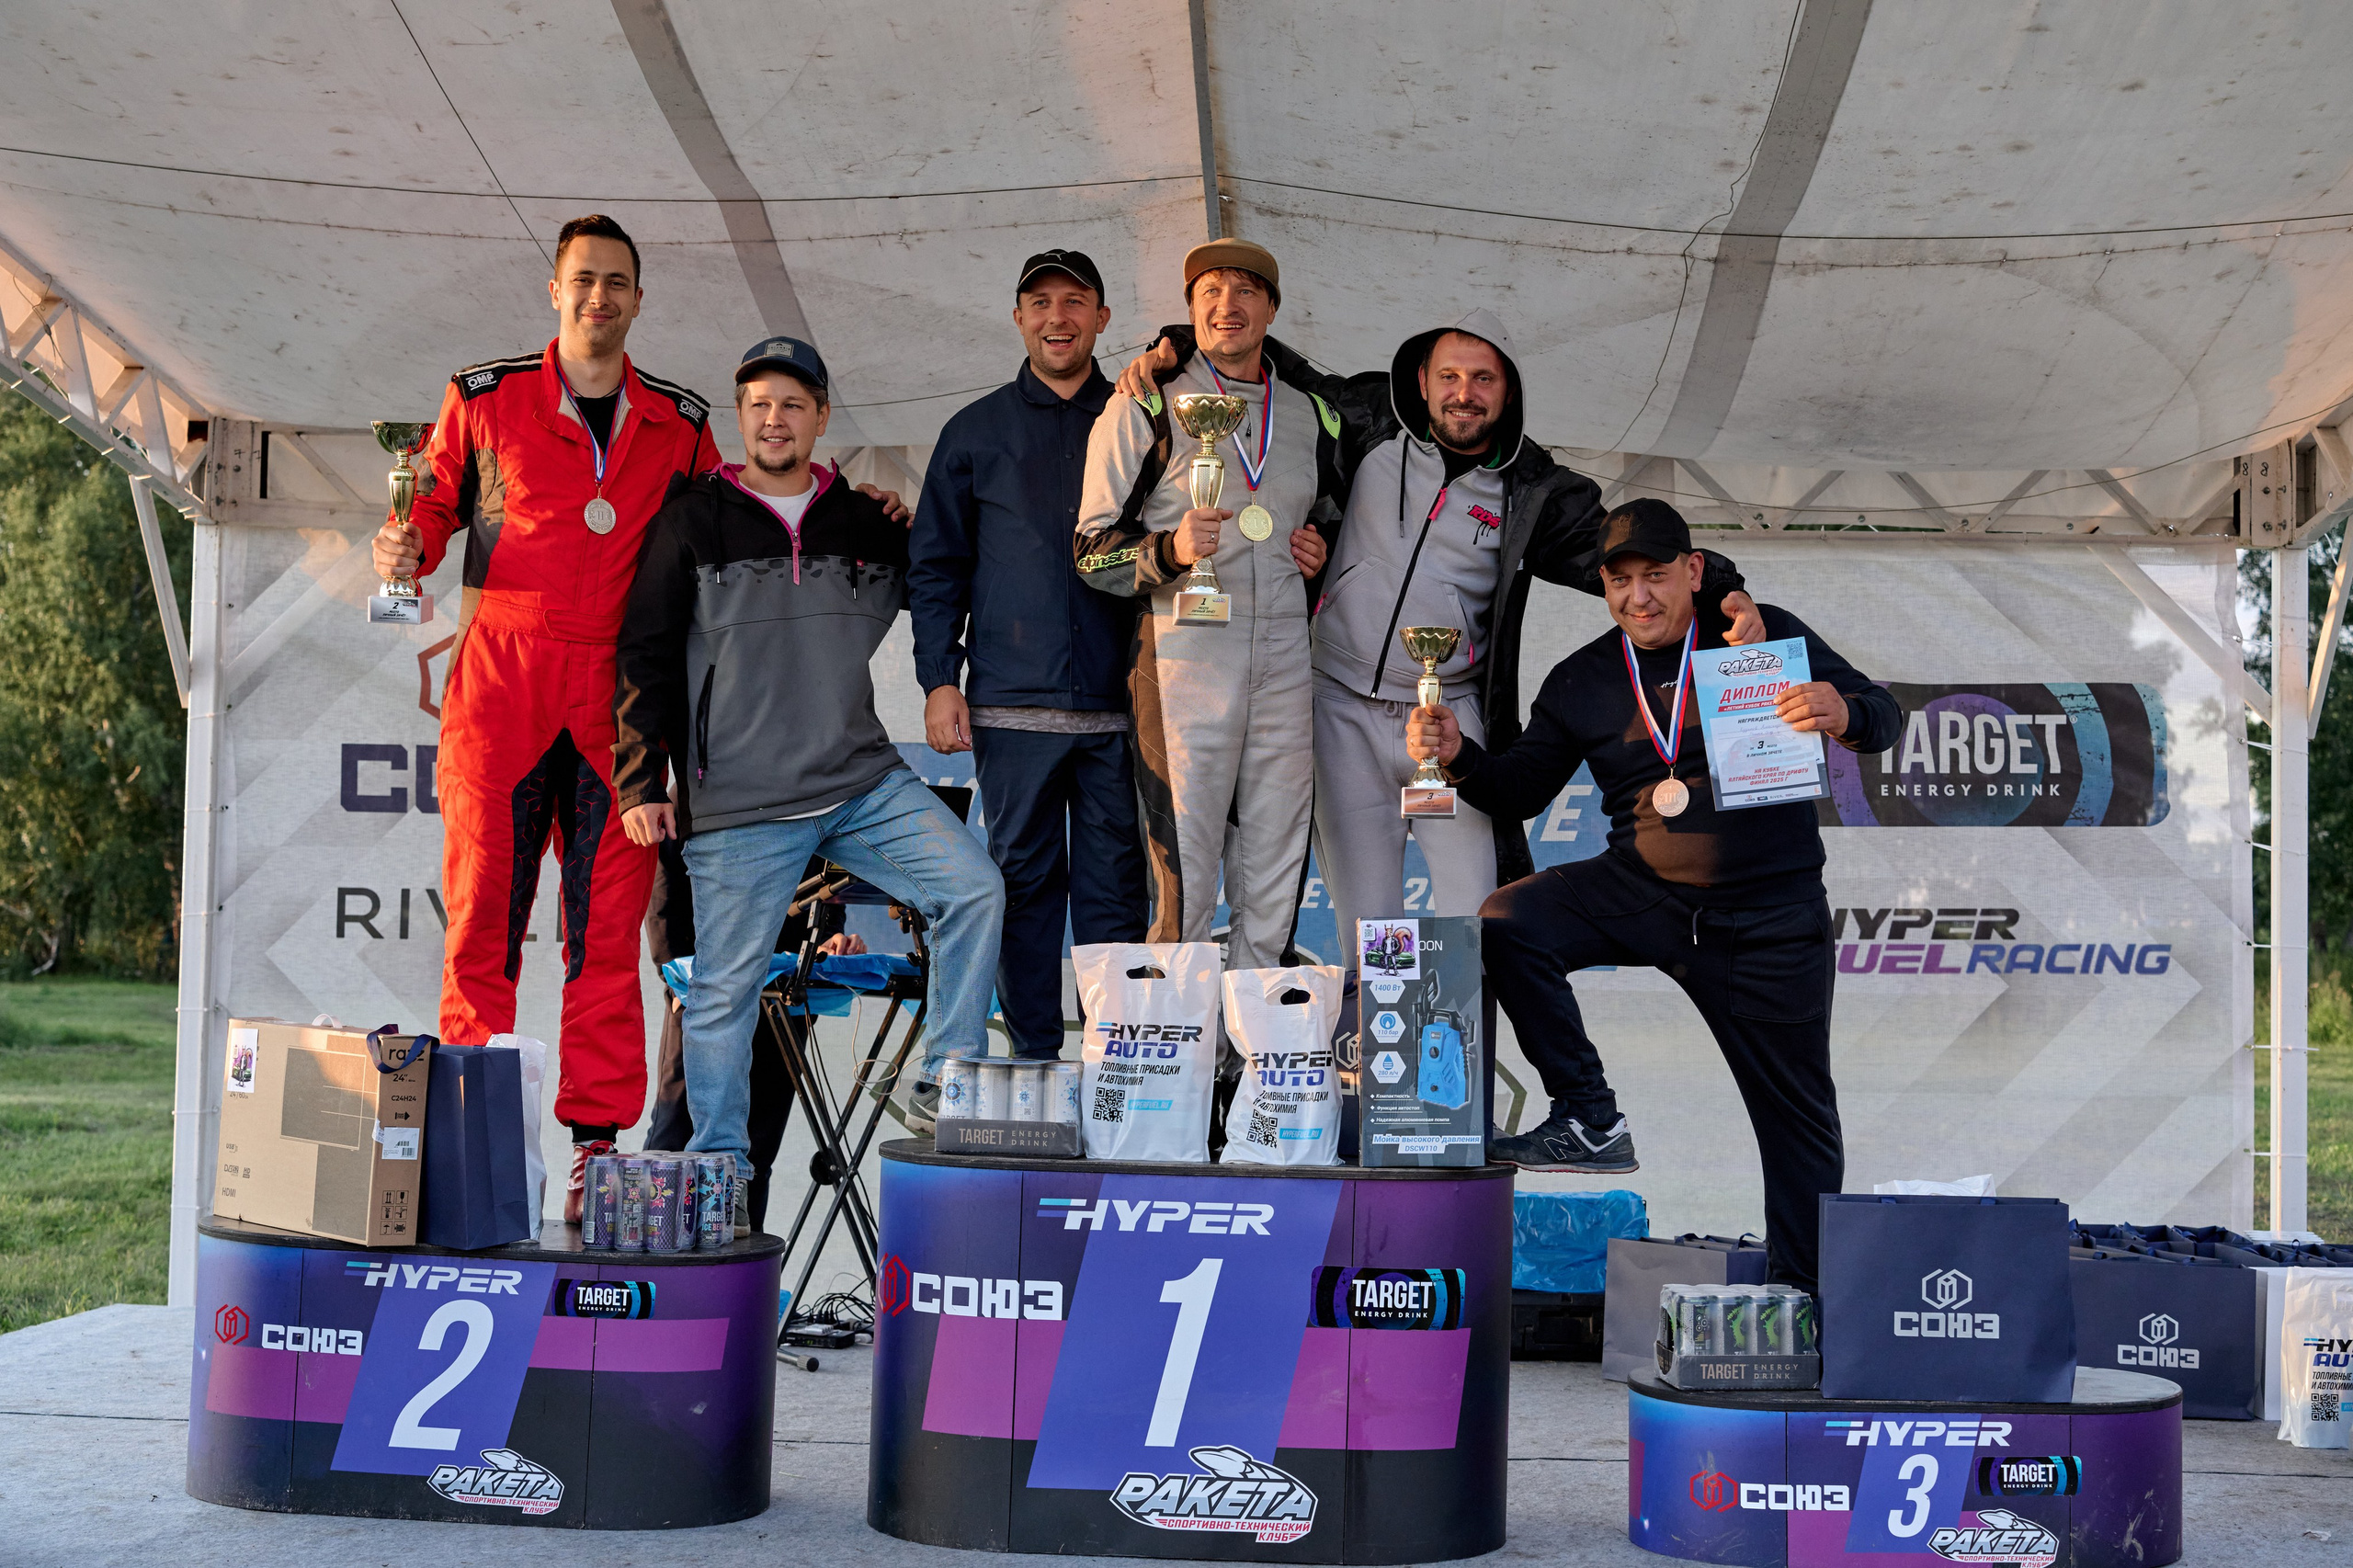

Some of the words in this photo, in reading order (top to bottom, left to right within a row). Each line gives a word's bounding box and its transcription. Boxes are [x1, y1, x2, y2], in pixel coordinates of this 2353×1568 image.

[467, 373, 494, 388] OMP
[679, 400, 703, 420] OMP
[392, 601, 399, 609] 2
[1719, 656, 1783, 676] РАКЕТА
[1719, 680, 1790, 704] ДИПЛОМ
[1757, 741, 1765, 750] 3
[1728, 774, 1762, 782] АЛТАЙСКОГО
[1881, 783, 1971, 797] ENERGY
[1987, 783, 2061, 797] DRINK
[1108, 1023, 1203, 1042] HYPER
[1104, 1040, 1178, 1059] AUTO
[1101, 1062, 1140, 1074] ТОПЛИВНЫЕ
[1140, 1064, 1180, 1075] ПРИСАДКИ
[1097, 1074, 1104, 1083] И
[1104, 1074, 1143, 1086] АВТОХИМИЯ
[1253, 1097, 1259, 1106] И
[1292, 1091, 1329, 1102] ПРИСАДКИ
[958, 1128, 1004, 1145] TARGET
[1011, 1131, 1057, 1139] ENERGY
[1373, 1134, 1400, 1142] Мойка
[1441, 1136, 1480, 1144] давления
[222, 1187, 236, 1197] HDMI
[1063, 1199, 1275, 1235] HYPER
[363, 1262, 523, 1295] HYPER
[577, 1287, 630, 1306] TARGET
[912, 1272, 1063, 1321] СОЮЗ
[1352, 1279, 1433, 1309] TARGET
[1893, 1312, 2000, 1339] СОЮЗ
[262, 1324, 363, 1356] СОЮЗ
[1144, 1258, 1223, 1447] 1
[2118, 1344, 2200, 1369] СОЮЗ
[388, 1299, 494, 1451] 2
[1700, 1364, 1746, 1380] TARGET
[2313, 1371, 2352, 1381] ТОПЛИВНЫЕ
[2311, 1381, 2317, 1390] И
[1846, 1421, 2012, 1447] HYPER
[430, 1465, 563, 1500] РАКЕТА
[2000, 1464, 2054, 1483] TARGET
[464, 1495, 559, 1507] СПОРТИВНО-ТЕХНИЧЕСКИЙ
[1116, 1474, 1314, 1520] РАКЕТА
[1740, 1483, 1849, 1511] СОЮЗ
[1887, 1453, 1939, 1538] 3
[1167, 1519, 1311, 1532] СПОРТИВНО-ТЕХНИЧЕСКИЙ
[1258, 1532, 1289, 1541] КЛУБ
[1931, 1528, 2058, 1555] РАКЕТА
